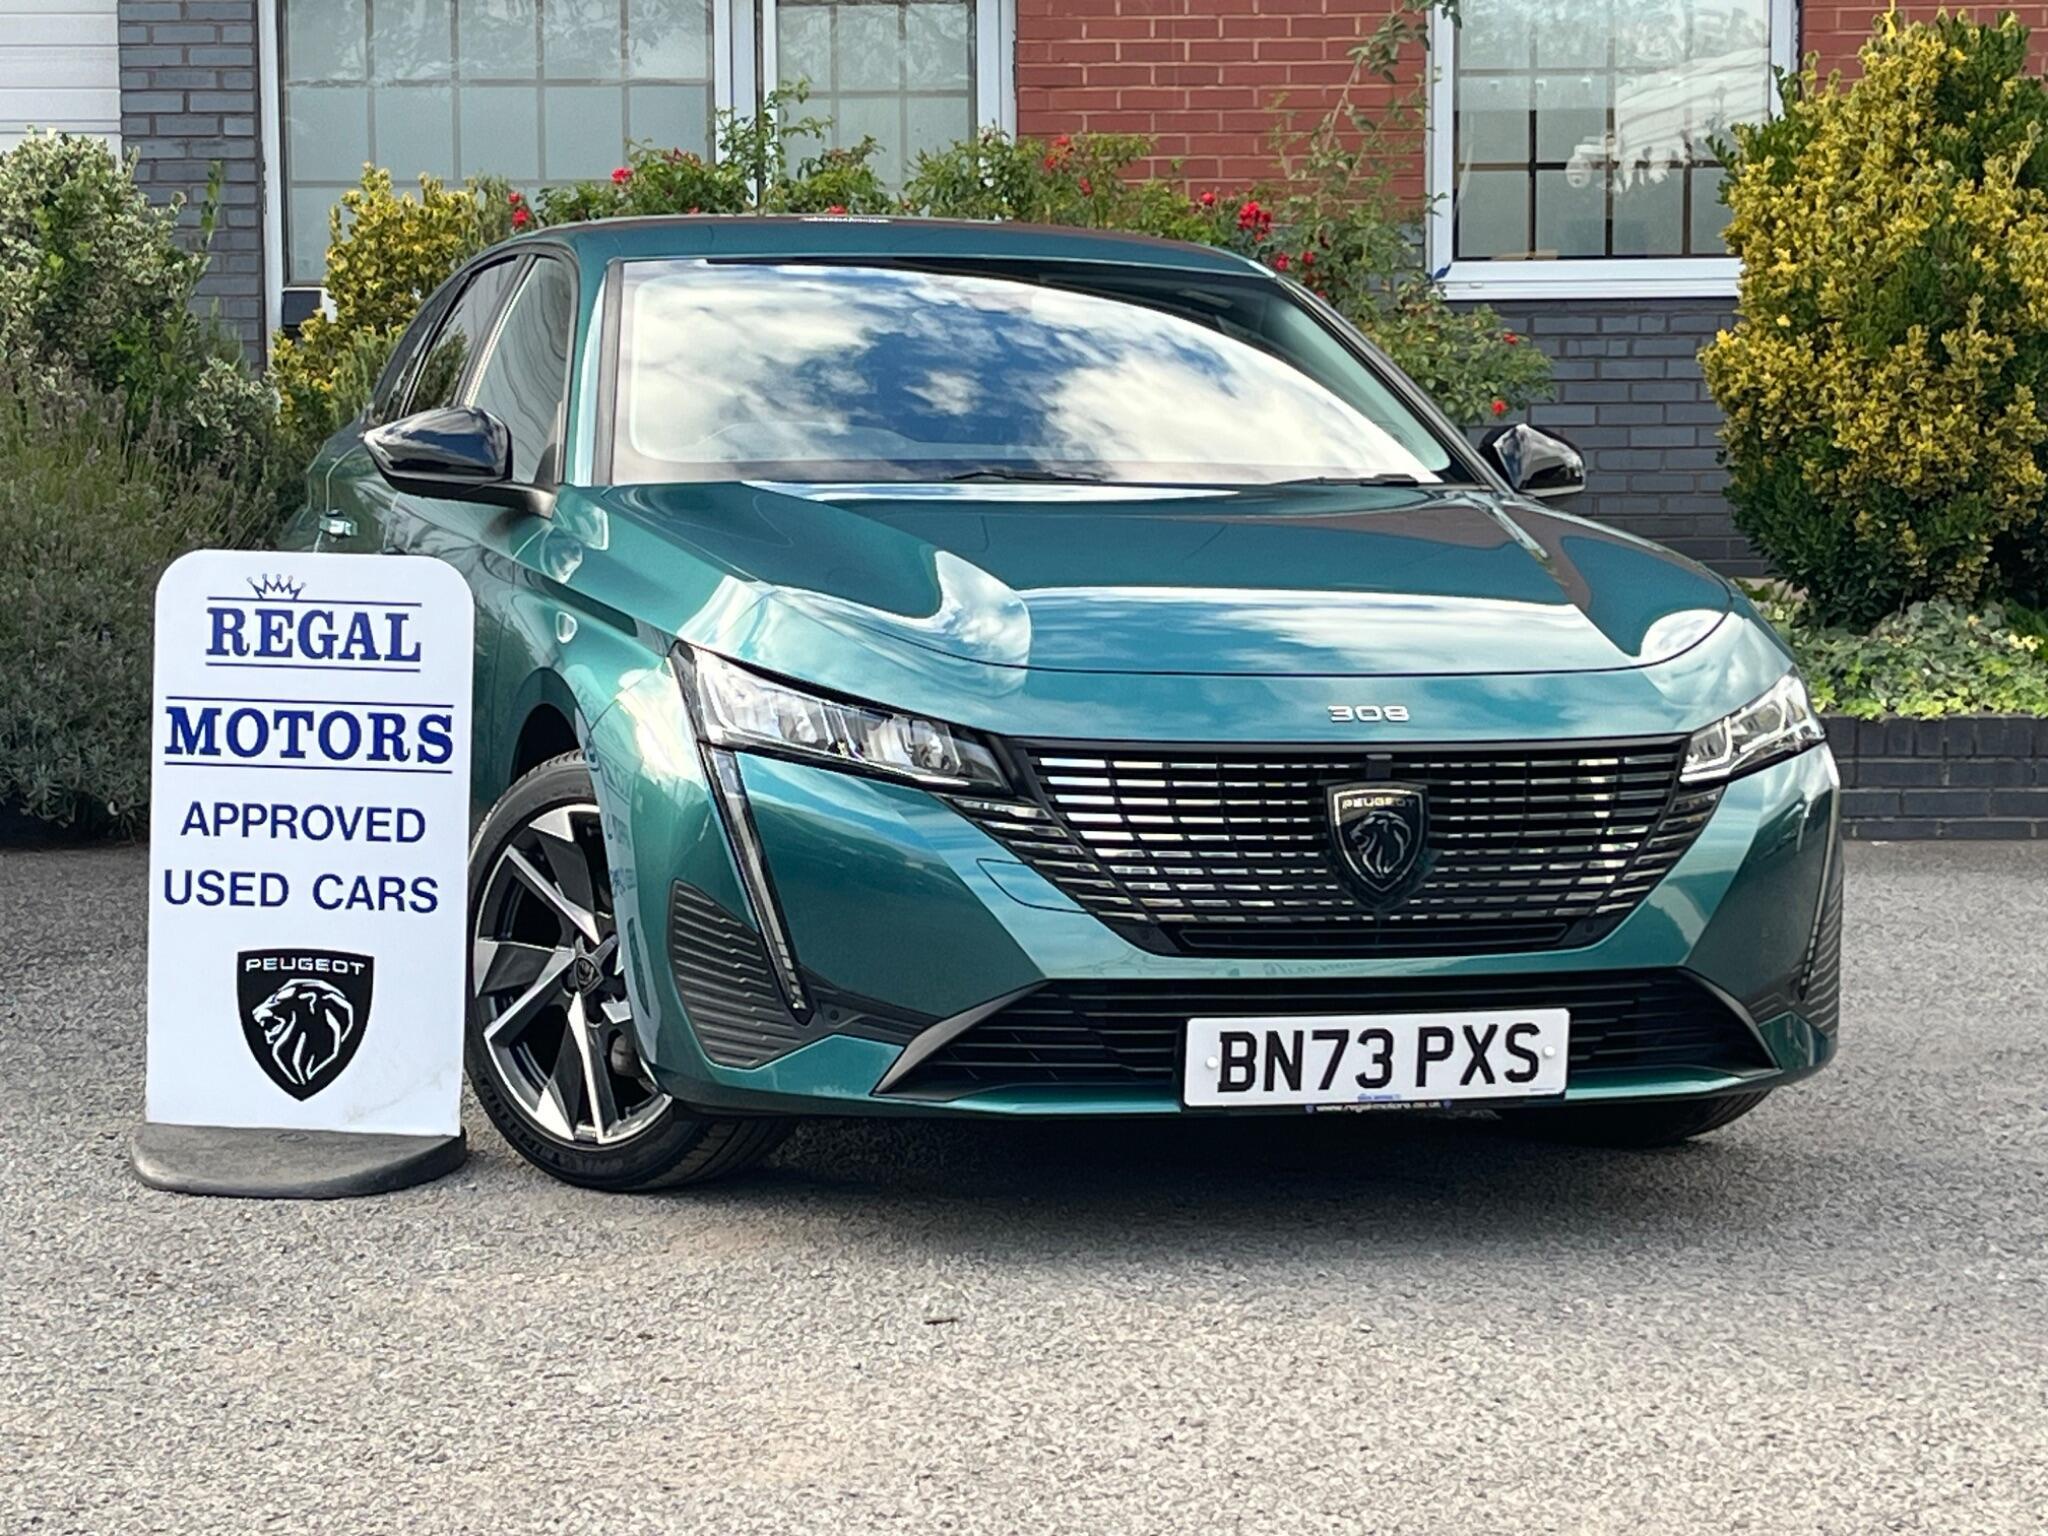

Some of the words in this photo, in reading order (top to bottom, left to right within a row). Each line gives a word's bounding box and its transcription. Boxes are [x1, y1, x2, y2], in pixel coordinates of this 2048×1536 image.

[206, 607, 421, 662] REGAL
[1327, 705, 1409, 721] 308
[164, 706, 453, 764] MOTORS
[180, 801, 426, 843] APPROVED
[1342, 797, 1414, 809] PEUGEOT
[164, 869, 289, 907] USED
[312, 873, 439, 914] CARS
[245, 957, 365, 975] PEUGEOT
[1217, 1028, 1394, 1093] BN73
[1415, 1022, 1541, 1087] PXS
